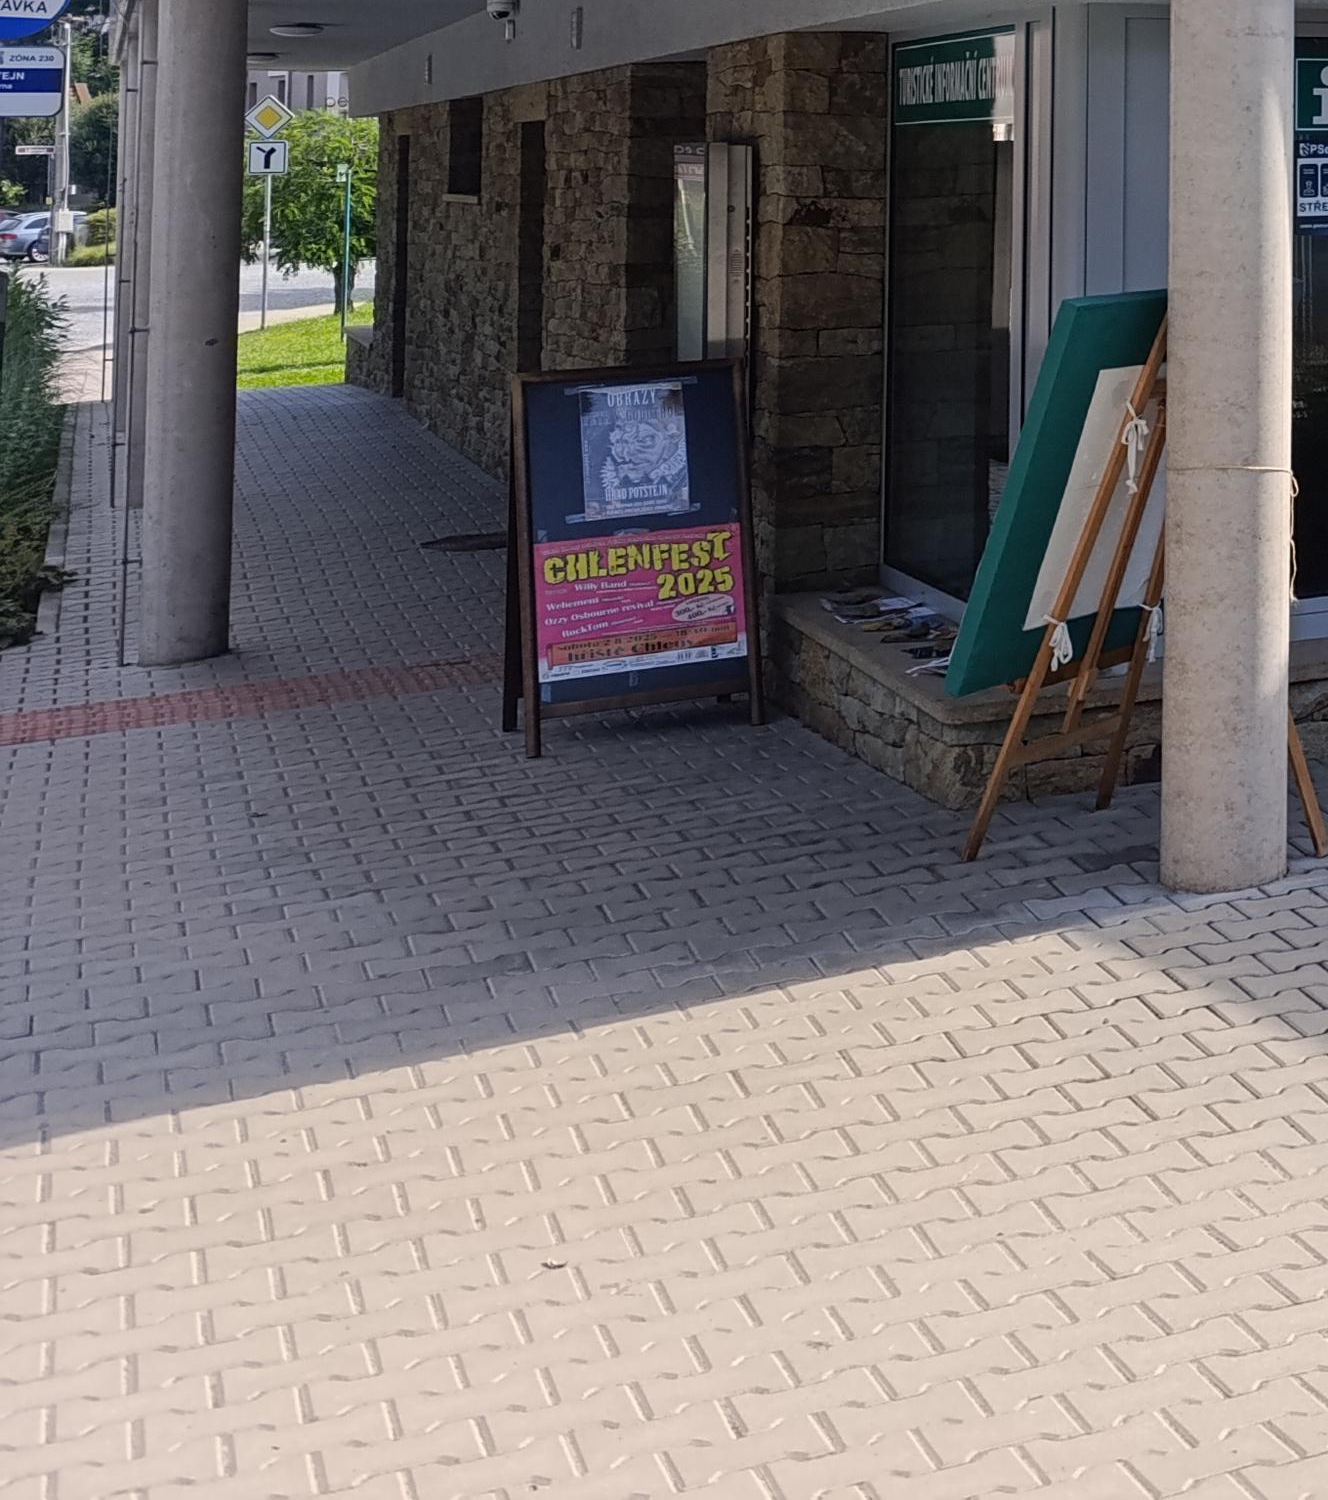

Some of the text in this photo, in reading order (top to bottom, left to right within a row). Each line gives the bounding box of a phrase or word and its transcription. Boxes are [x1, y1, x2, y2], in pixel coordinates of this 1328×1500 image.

[38, 54, 55, 62] 230
[0, 71, 25, 80] EJN
[899, 55, 934, 106] TURISTICKÉ
[935, 50, 978, 103] INFORMAČNÍ
[543, 531, 732, 585] CHLENFEST
[574, 582, 599, 592] Willy
[600, 580, 628, 590] Band
[656, 566, 735, 600] 2025
[544, 616, 568, 627] Ozzy
[571, 607, 621, 621] Osbourne
[621, 600, 655, 612] revival
